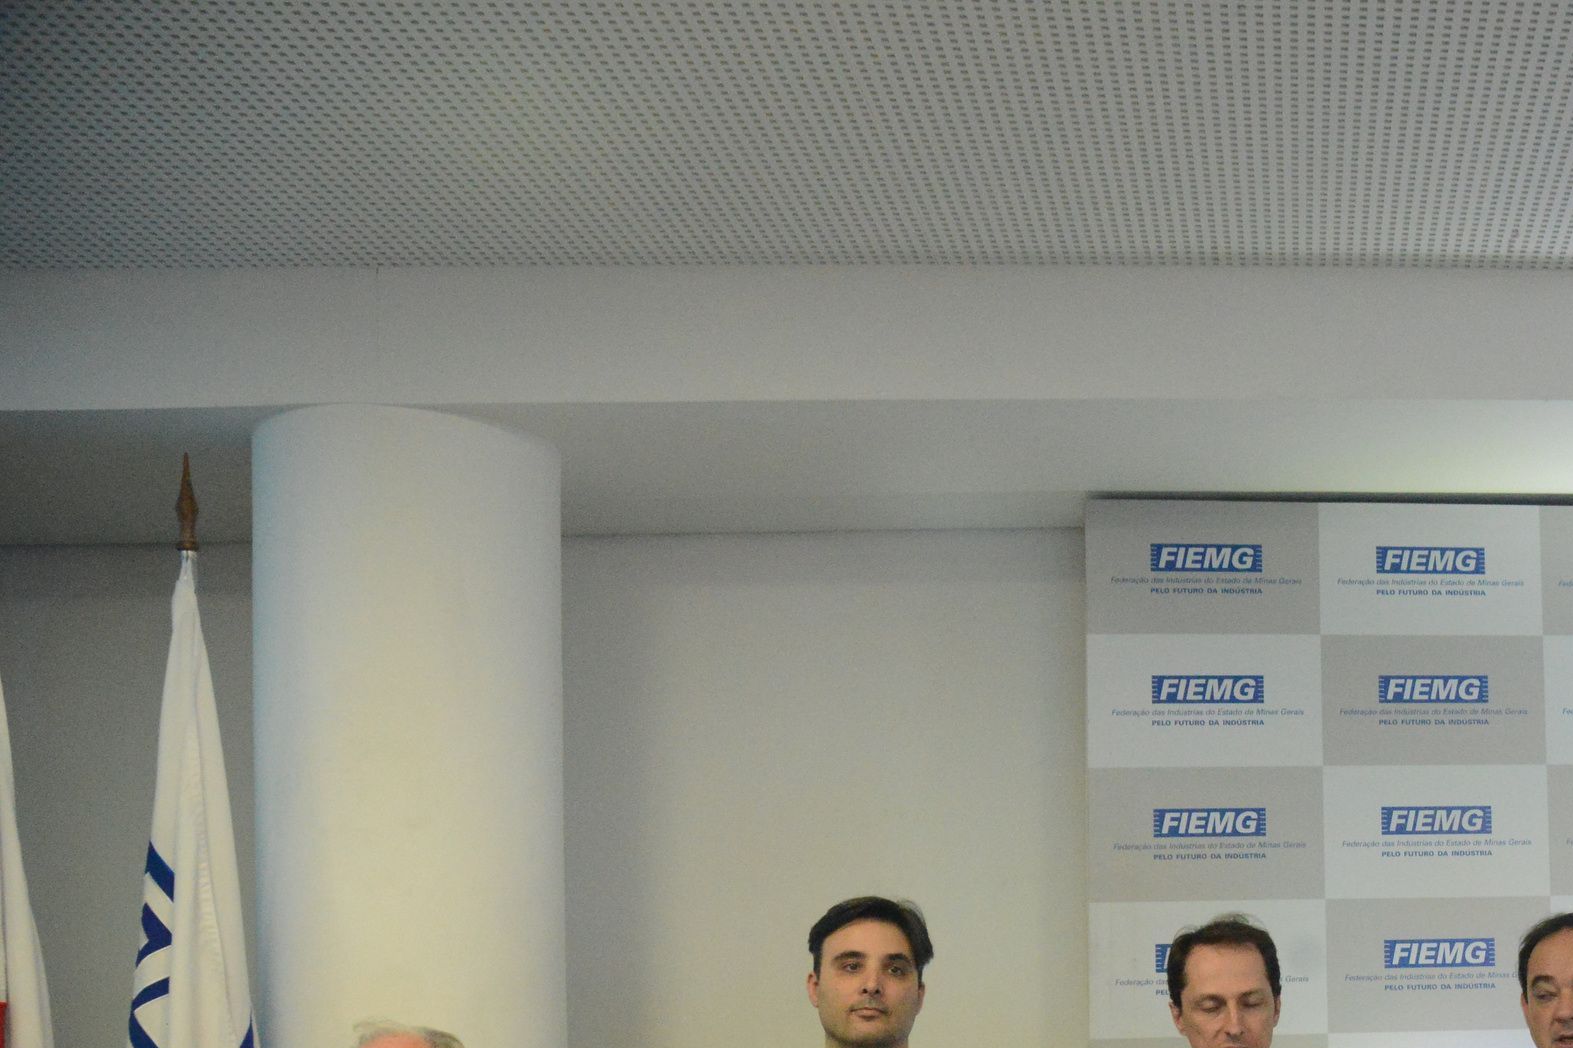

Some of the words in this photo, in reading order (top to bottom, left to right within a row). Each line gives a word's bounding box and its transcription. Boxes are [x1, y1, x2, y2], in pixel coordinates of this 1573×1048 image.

[1159, 546, 1254, 569] FIEMG
[1384, 549, 1477, 572] FIEMG
[1160, 678, 1256, 700] FIEMG
[1387, 678, 1480, 700] FIEMG
[1162, 811, 1258, 834] FIEMG
[1389, 809, 1483, 832] FIEMG
[1176, 853, 1208, 861] FUTURO
[1392, 941, 1487, 965] FIEMG
[1407, 984, 1438, 992] FUTURO
